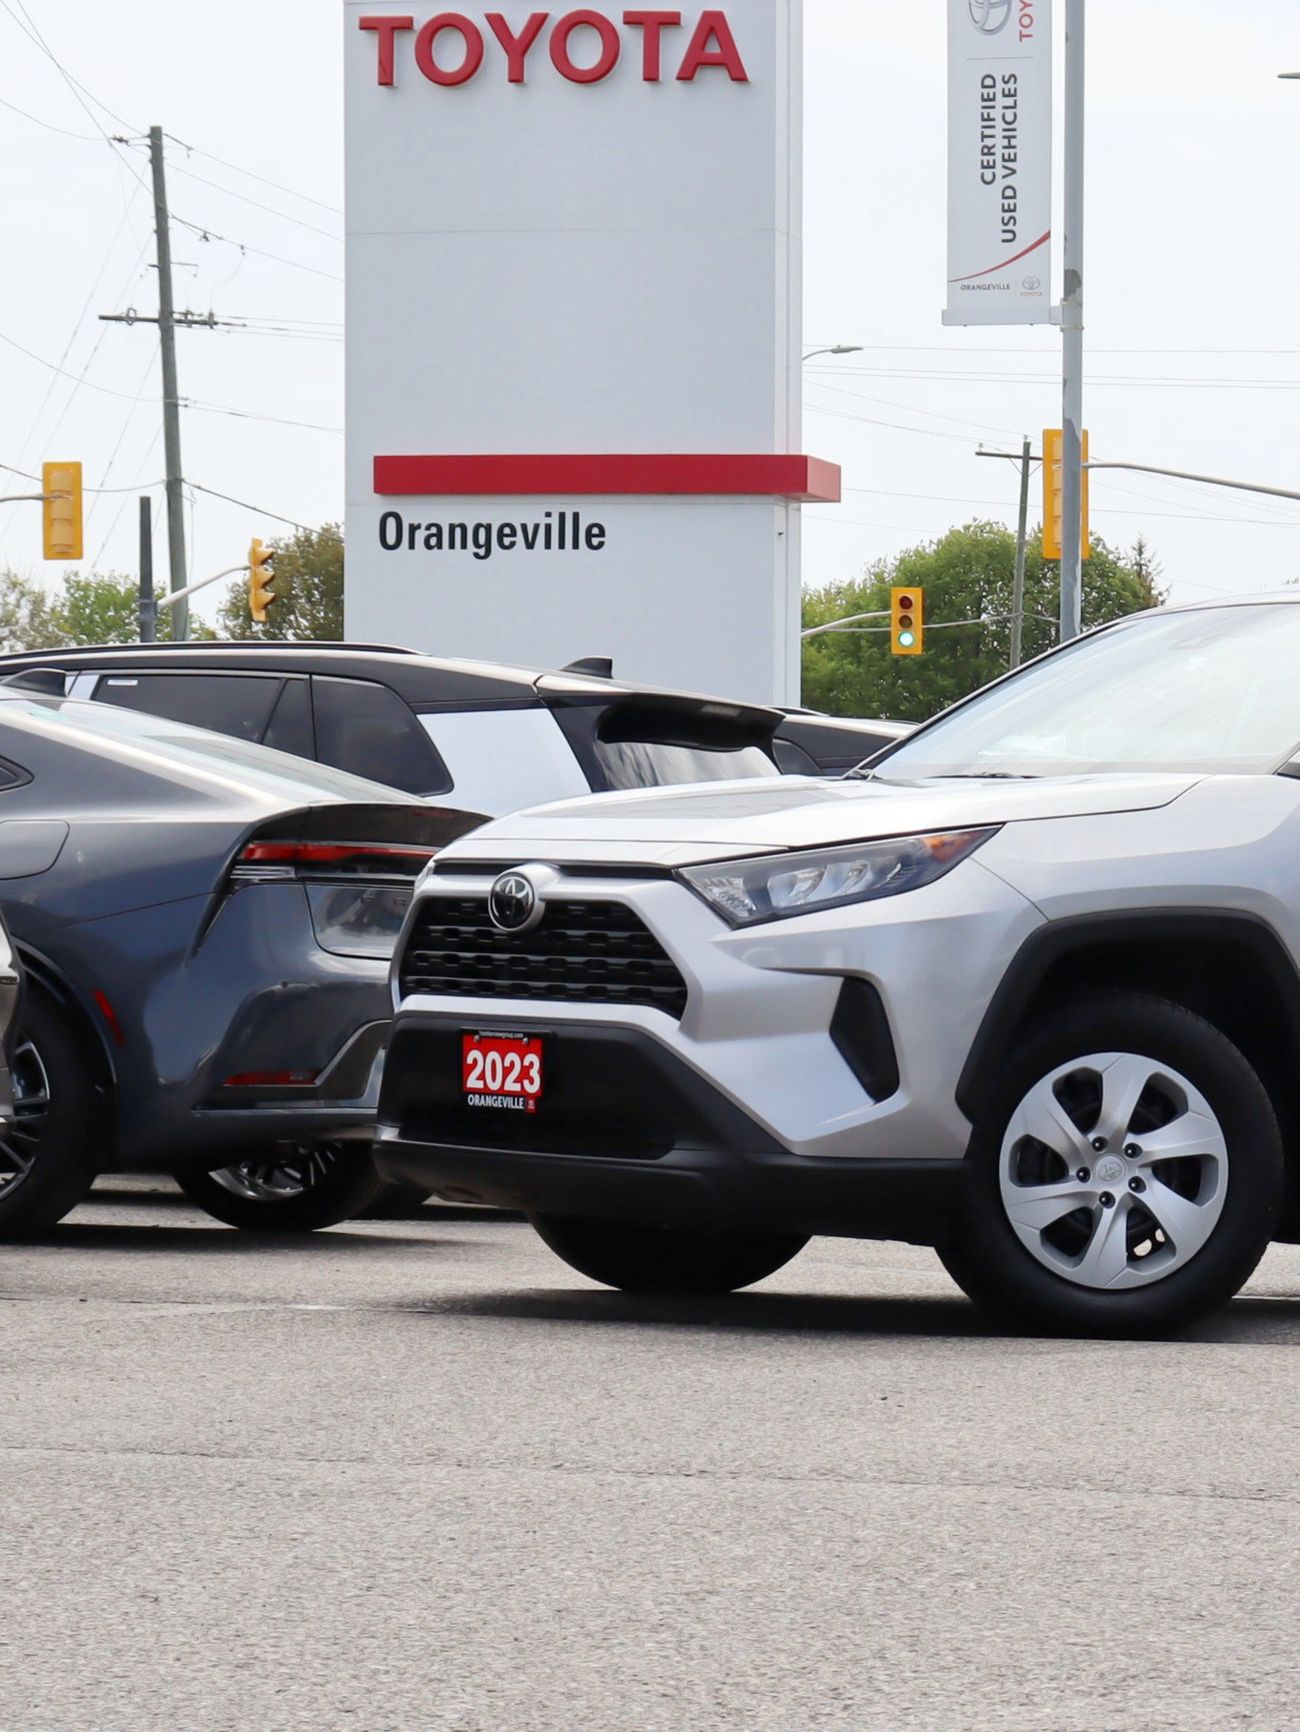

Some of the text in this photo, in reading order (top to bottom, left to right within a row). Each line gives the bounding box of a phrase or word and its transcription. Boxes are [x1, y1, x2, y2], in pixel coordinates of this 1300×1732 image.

[359, 9, 749, 87] TOYOTA
[981, 74, 996, 185] CERTIFIED
[1001, 73, 1017, 243] USED VEHICLES
[379, 511, 606, 560] Orangeville
[466, 1049, 541, 1094] 2023
[467, 1094, 524, 1109] ORANGEVILLE
